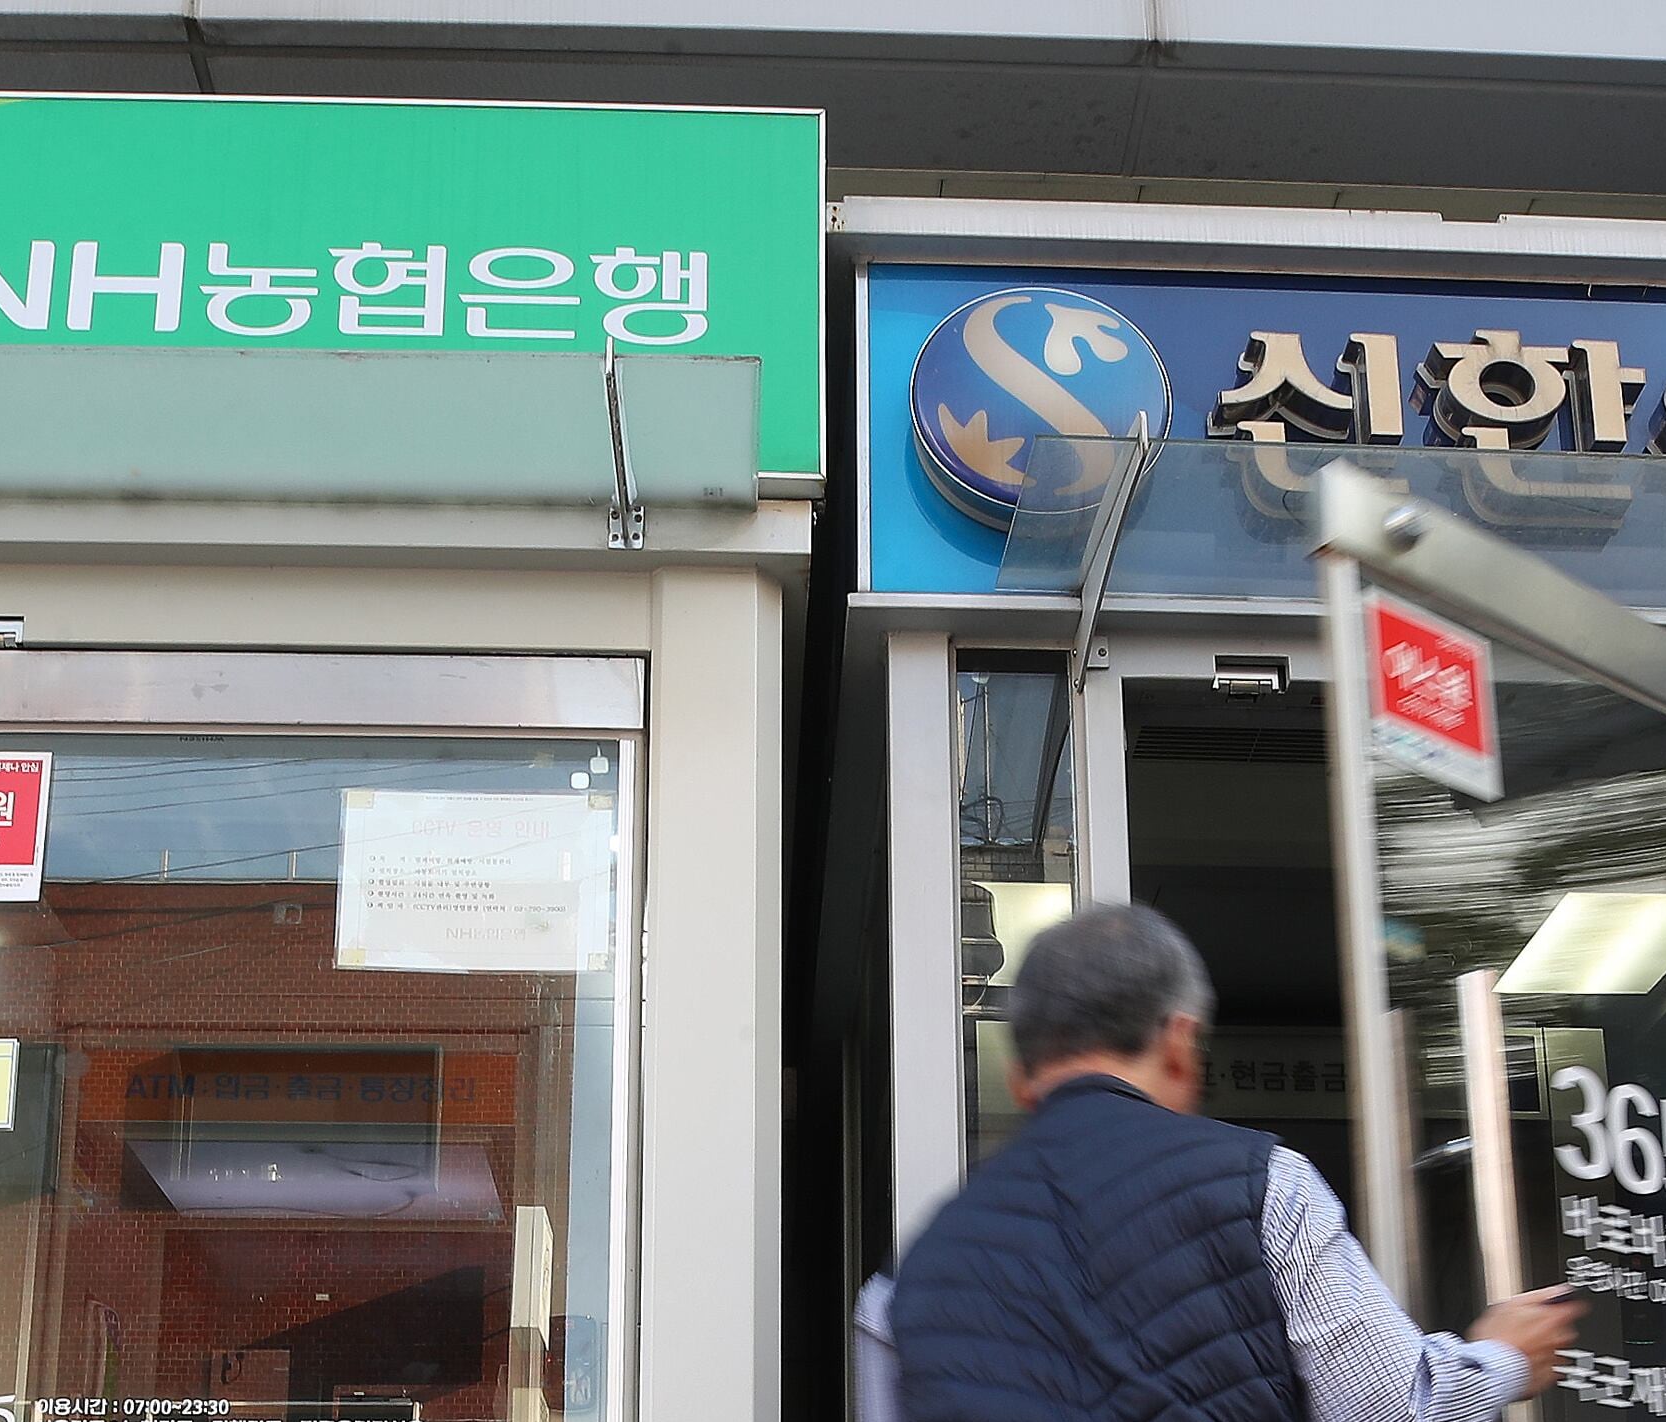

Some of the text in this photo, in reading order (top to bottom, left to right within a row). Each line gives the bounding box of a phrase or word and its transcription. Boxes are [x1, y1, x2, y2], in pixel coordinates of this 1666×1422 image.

[126, 1075, 195, 1100] ATM
[38, 1398, 230, 1416] 이용시간 07:00~23:30
